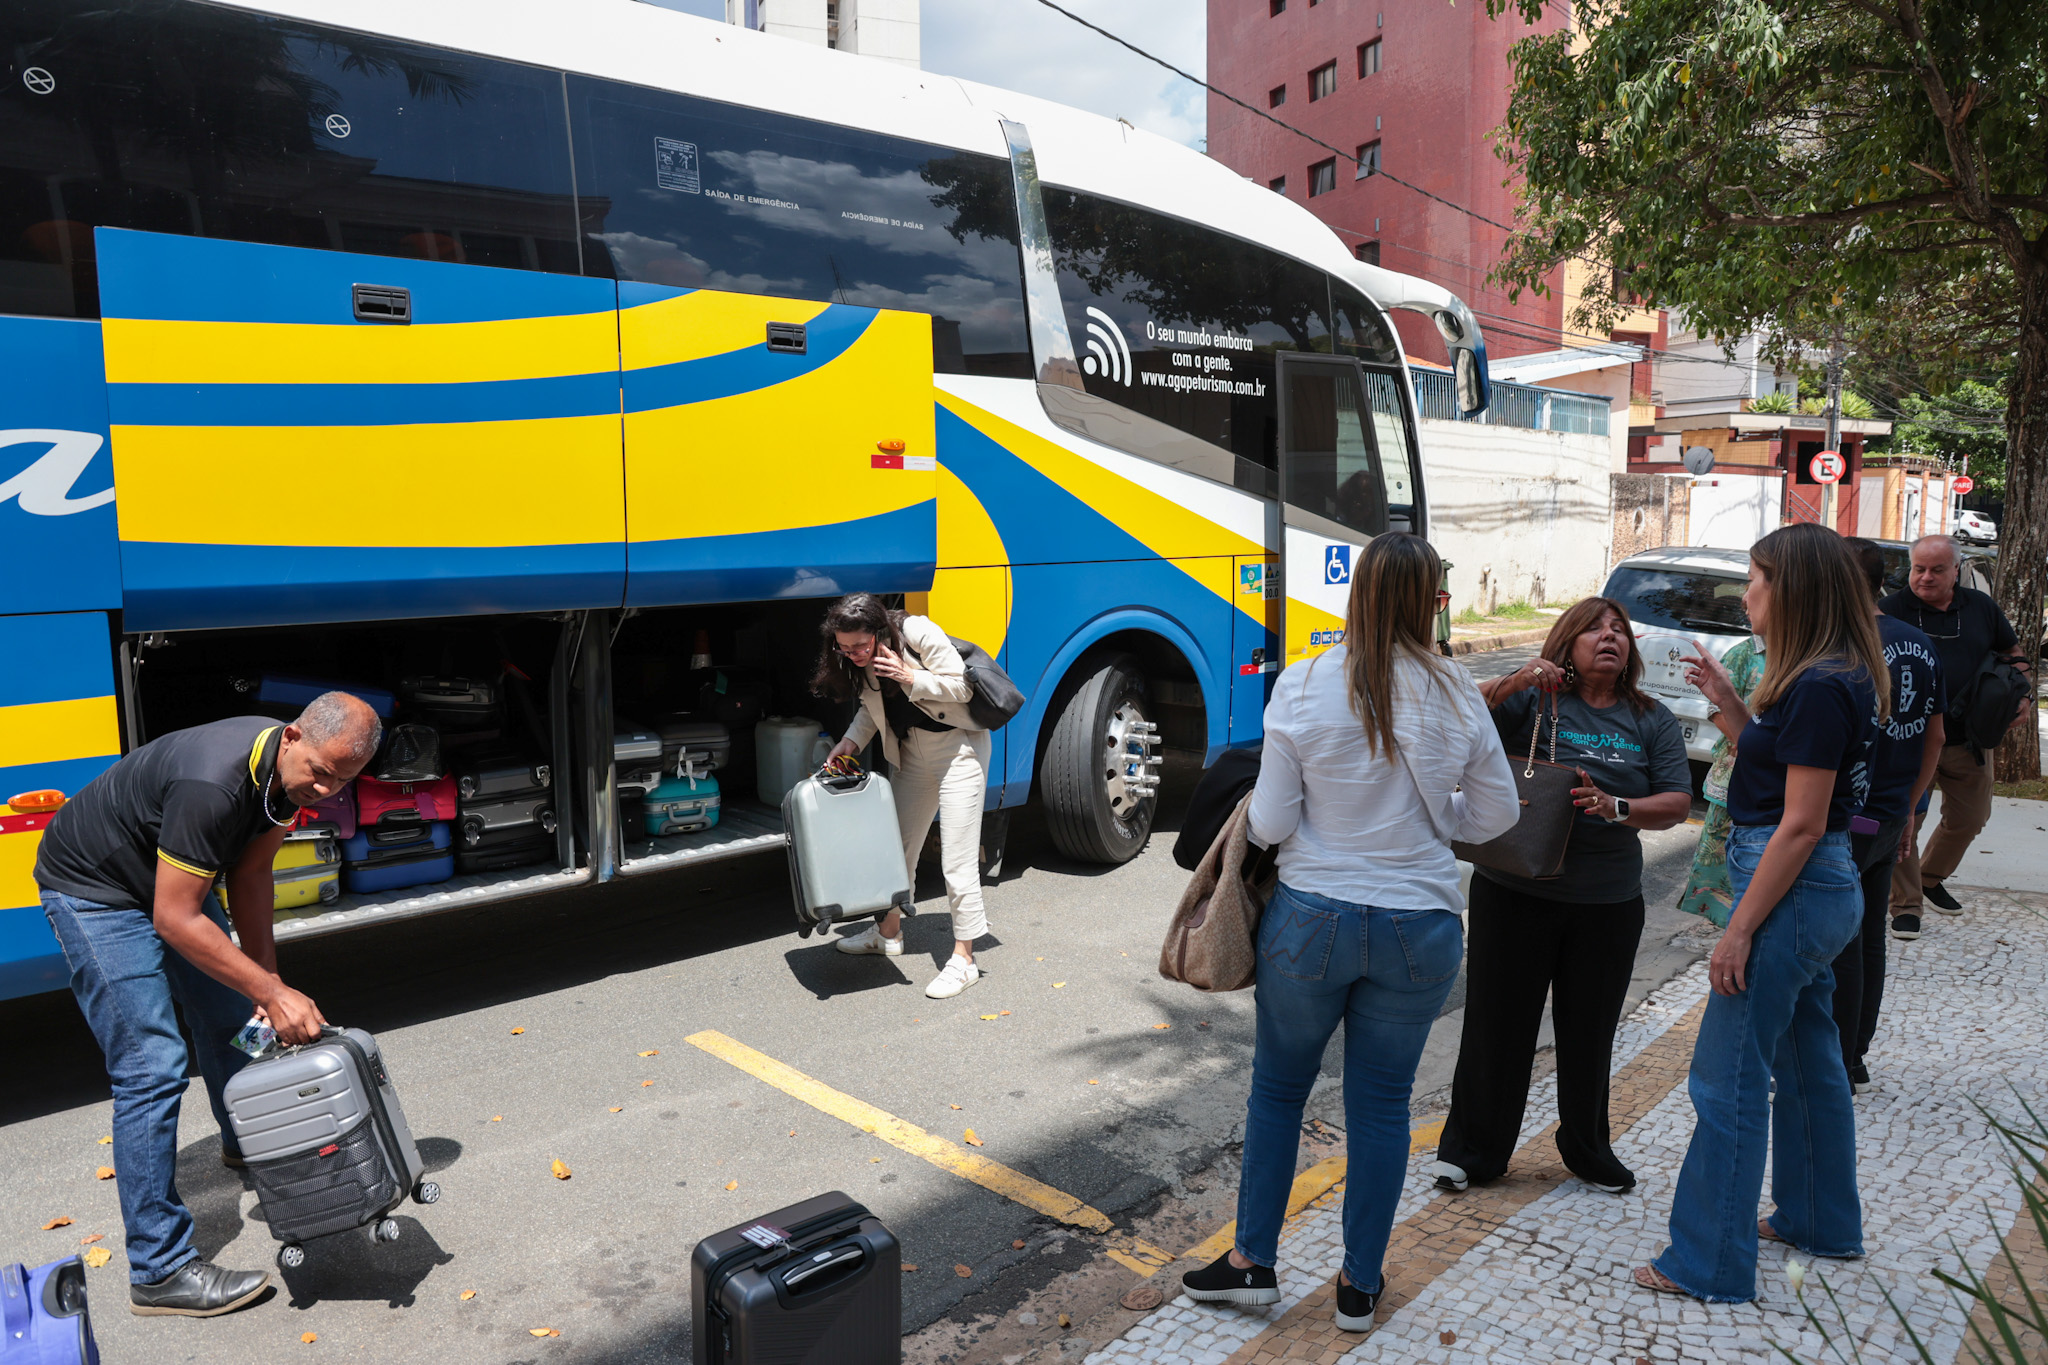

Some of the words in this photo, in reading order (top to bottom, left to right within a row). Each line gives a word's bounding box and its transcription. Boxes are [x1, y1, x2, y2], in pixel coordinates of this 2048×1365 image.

[705, 189, 731, 200] SAÍDA
[733, 193, 745, 202] DE
[747, 196, 800, 210] EMERGÊNCIA
[1146, 320, 1155, 340] O
[1157, 327, 1175, 343] seu
[1177, 327, 1212, 347] mundo
[1213, 330, 1253, 352] embarca
[1172, 352, 1192, 367] com
[1194, 355, 1201, 368] a
[1203, 355, 1233, 373] gente.
[1141, 371, 1266, 397] www.agapeturismo.com.br
[1821, 458, 1834, 476] E
[1895, 641, 1935, 670] LUGAR
[1558, 731, 1598, 742] agente
[1571, 738, 1589, 746] com
[1612, 741, 1641, 752] gente
